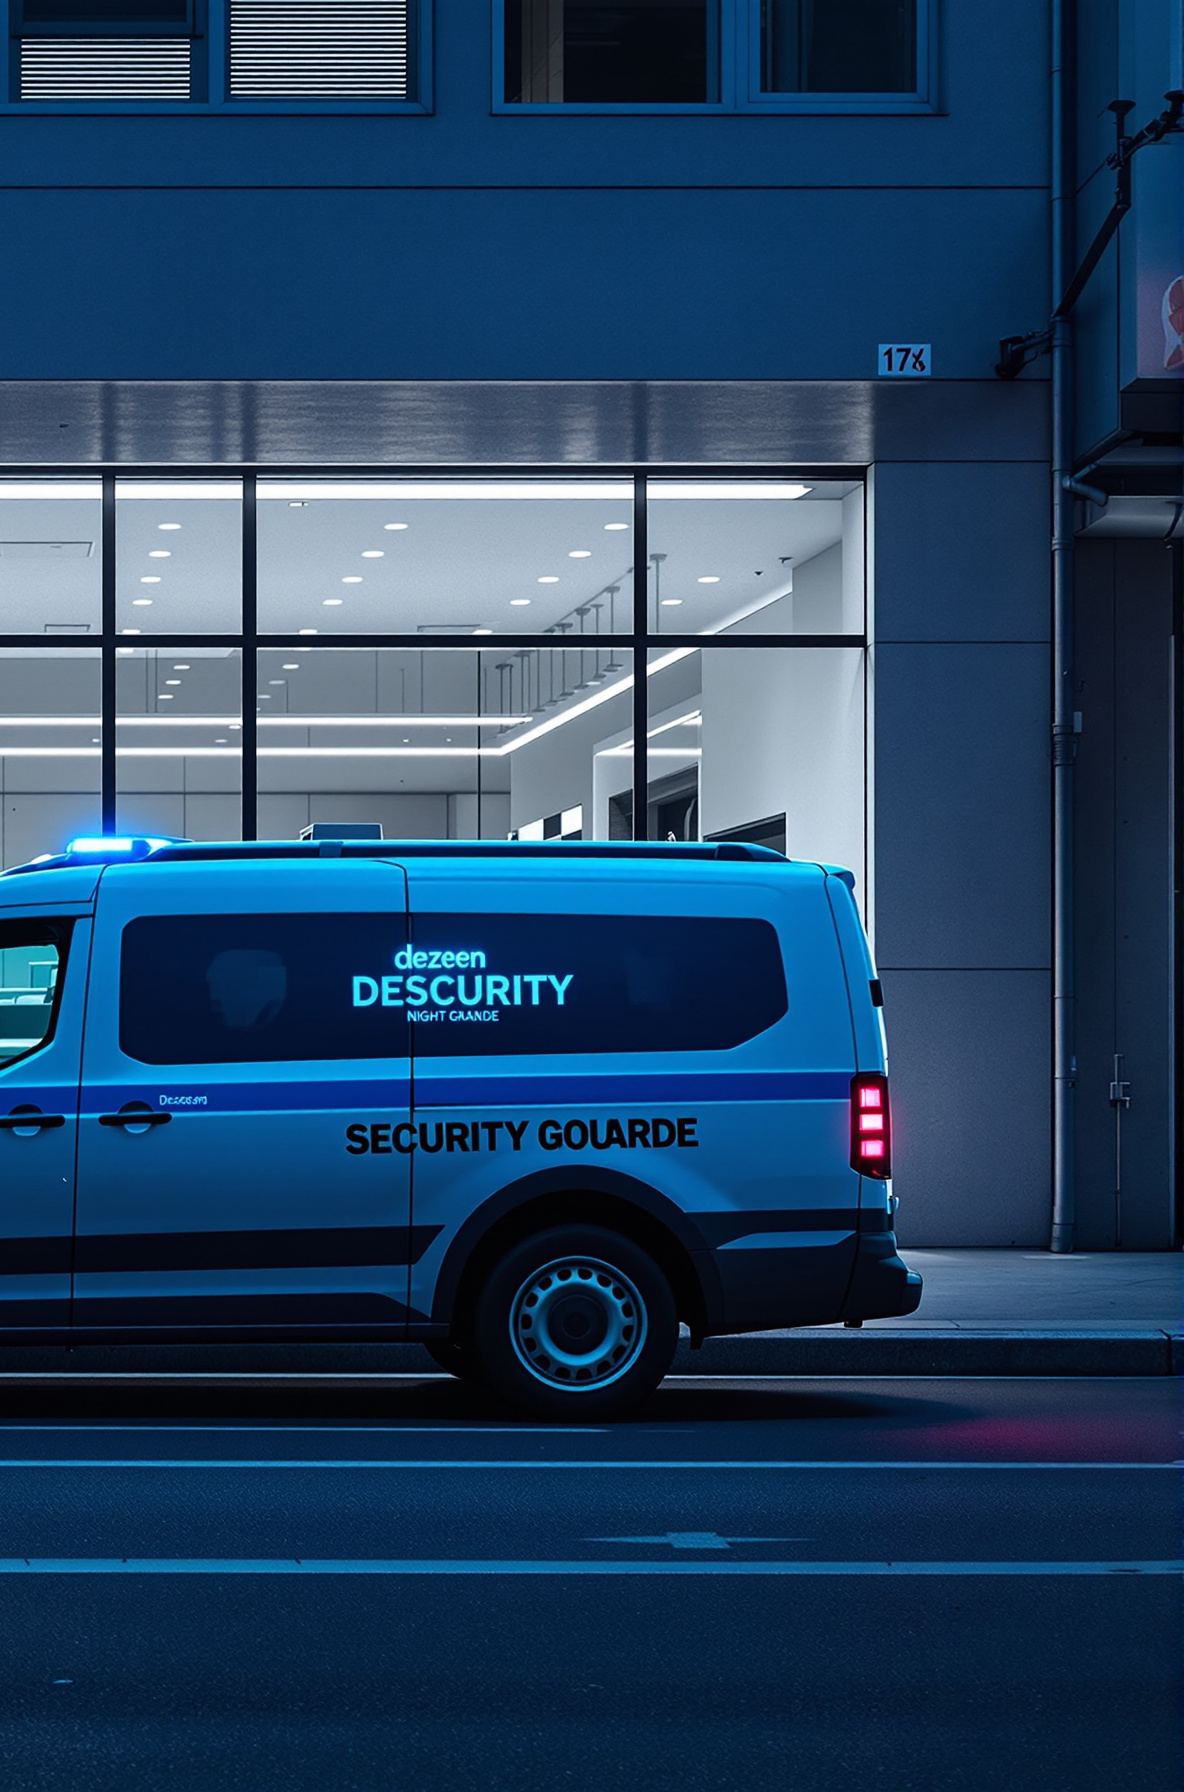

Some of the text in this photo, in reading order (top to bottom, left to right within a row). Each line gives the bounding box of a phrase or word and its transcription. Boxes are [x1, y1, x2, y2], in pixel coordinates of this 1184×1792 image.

[394, 944, 486, 970] dezeen
[352, 974, 574, 1007] DESCURITY
[406, 1010, 447, 1022] NIGHT
[345, 1119, 530, 1155] SECURITY
